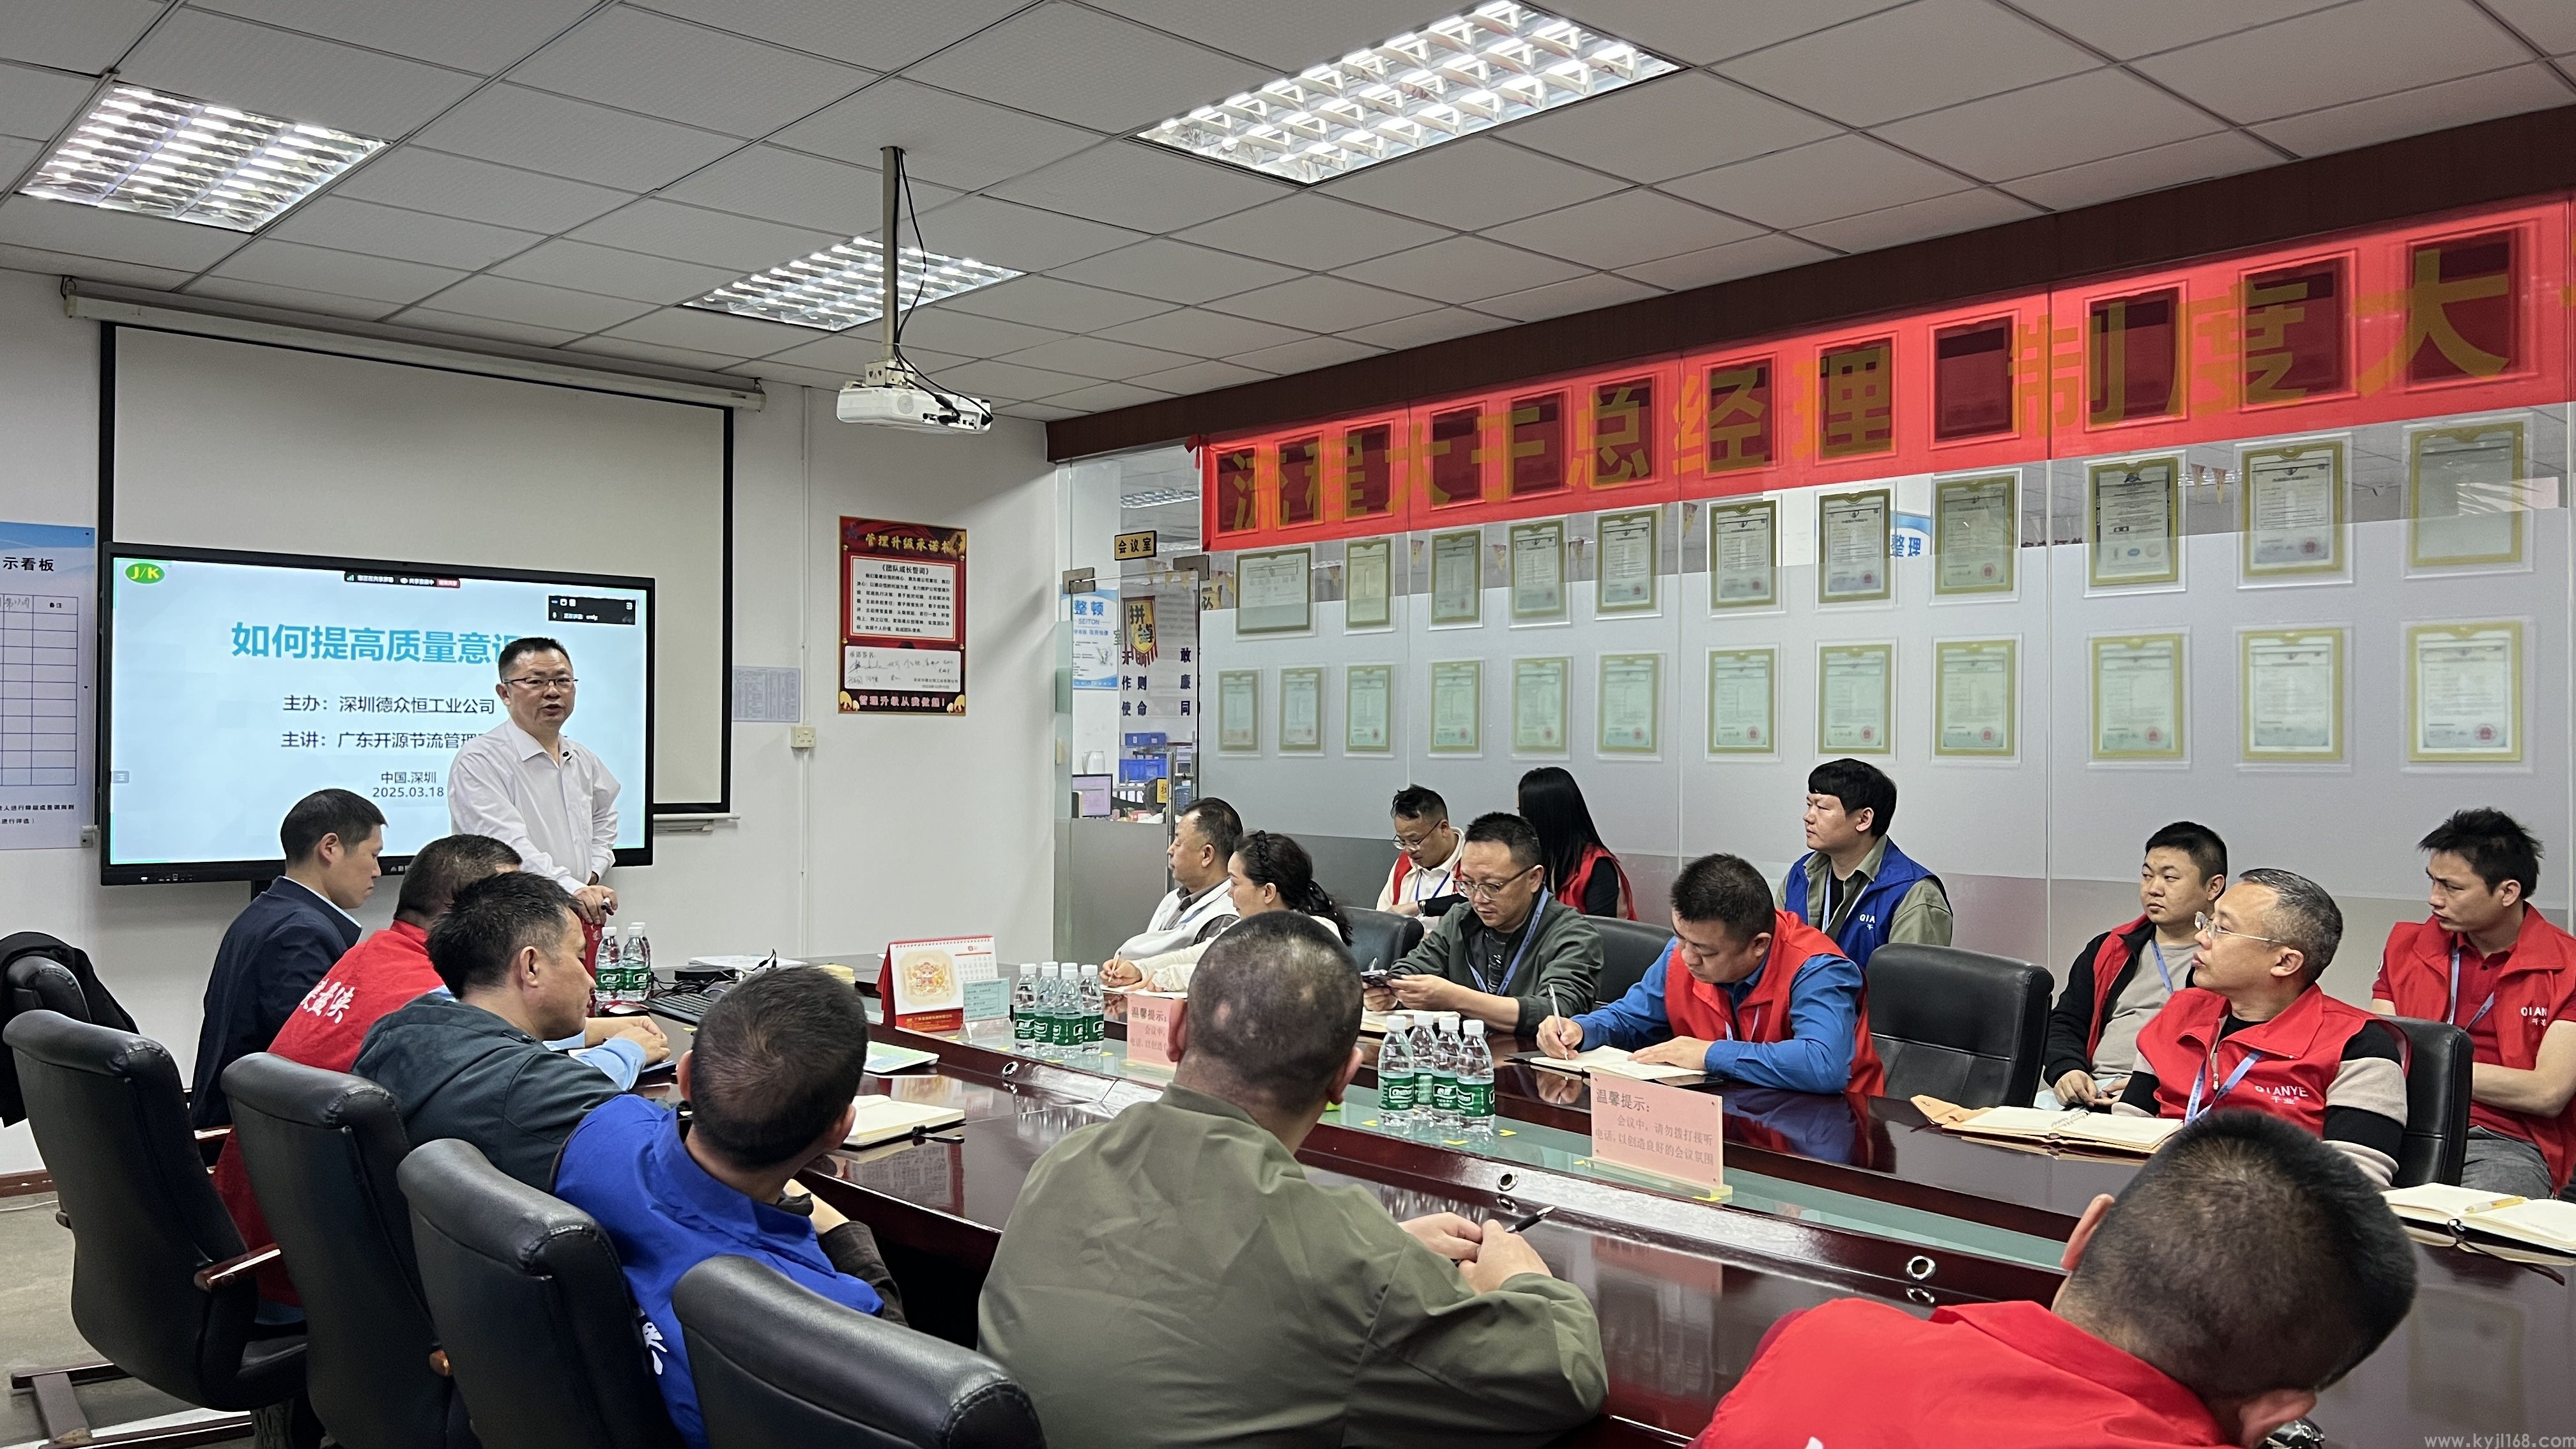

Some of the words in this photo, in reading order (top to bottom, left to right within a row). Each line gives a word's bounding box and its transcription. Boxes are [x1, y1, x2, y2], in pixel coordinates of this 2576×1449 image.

[2008, 248, 2576, 436] 制度大
[1118, 537, 1151, 554] 会议室
[1890, 535, 1921, 557] 整理
[3, 556, 54, 572] 示看板
[1073, 599, 1104, 616] 整顿
[281, 731, 484, 749] 主讲：广东开源节流管理
[372, 786, 444, 797] 2025.03.18
[1596, 1087, 1650, 1112] 温馨提示：
